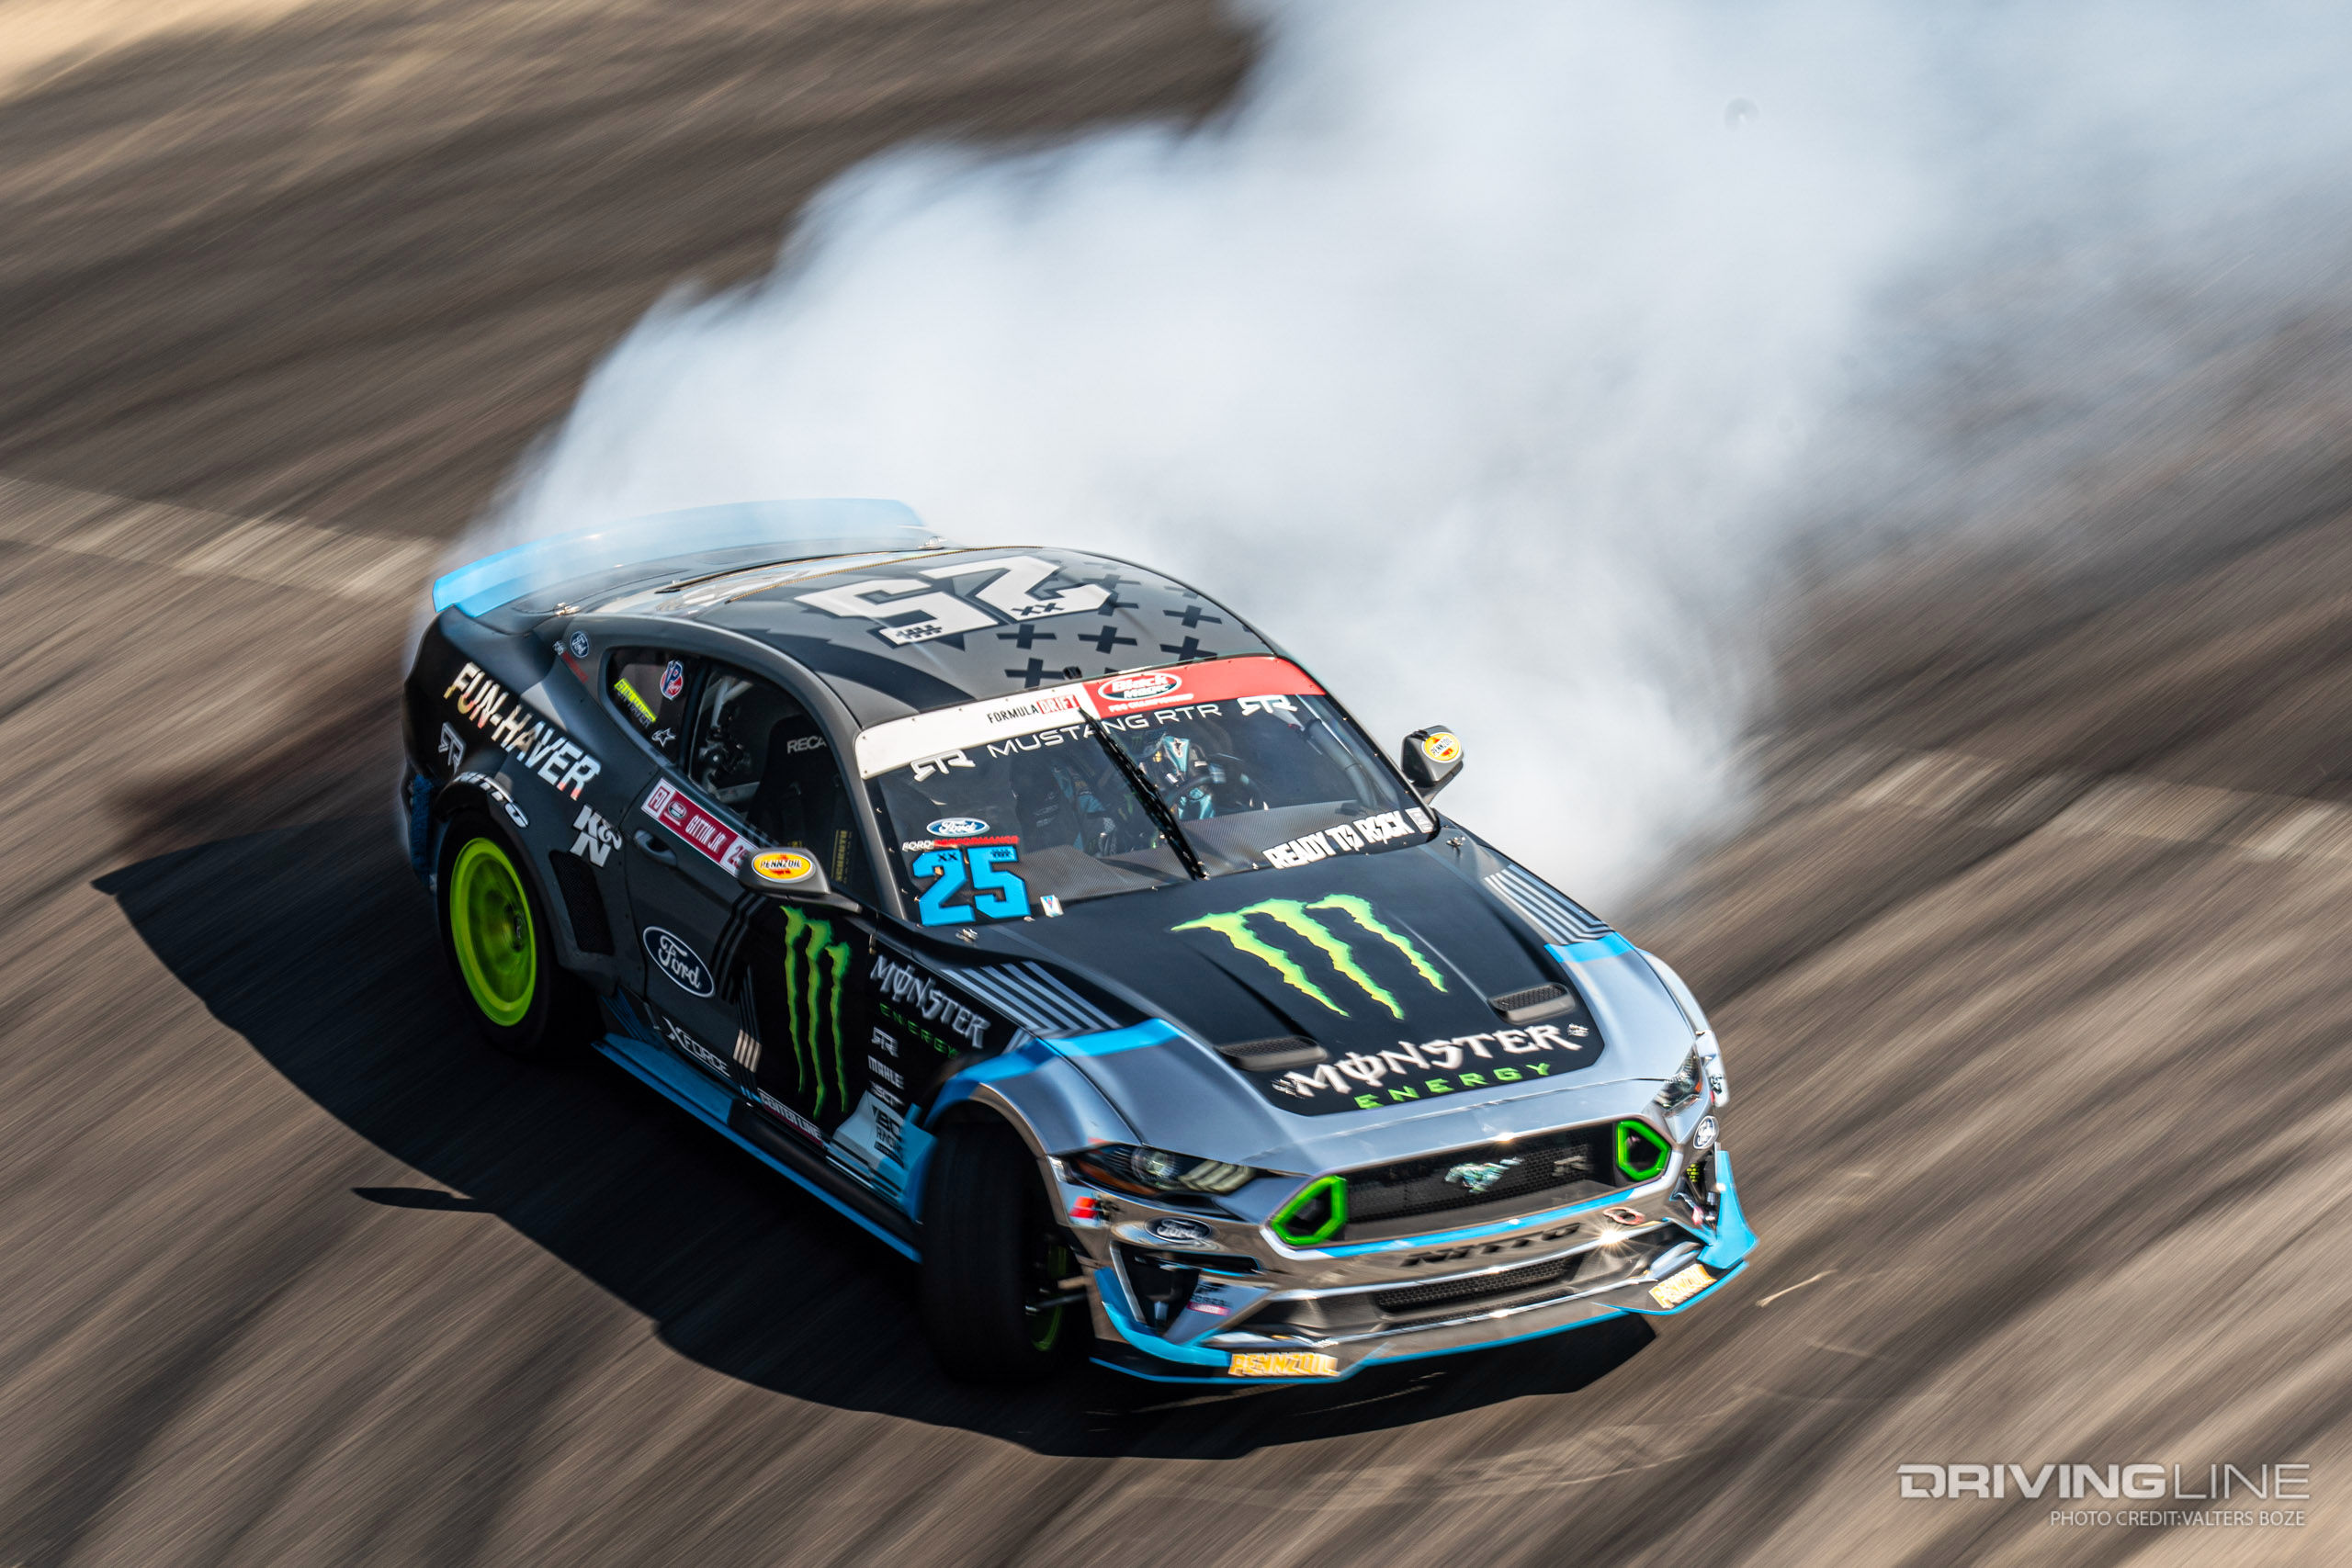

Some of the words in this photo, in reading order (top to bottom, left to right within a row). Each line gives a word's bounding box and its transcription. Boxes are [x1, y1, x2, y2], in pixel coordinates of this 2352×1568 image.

[987, 704, 1039, 724] FORMULA
[1037, 694, 1080, 715] DRIFT
[1154, 703, 1223, 725] RTR
[443, 661, 602, 802] FUN-HAVER
[786, 735, 827, 754] RECA
[569, 804, 623, 868] K&N
[684, 815, 716, 846] GITTIN
[707, 831, 727, 853] JR
[937, 819, 980, 836] Ford
[760, 858, 803, 870] PENNZOIL
[1261, 830, 1337, 870] READY
[912, 844, 1032, 927] 25
[656, 932, 704, 992] Ford
[879, 1001, 961, 1058] ENERGY
[1353, 1062, 1551, 1110] ENERGY
[1228, 1352, 1340, 1377] PENNZOIL
